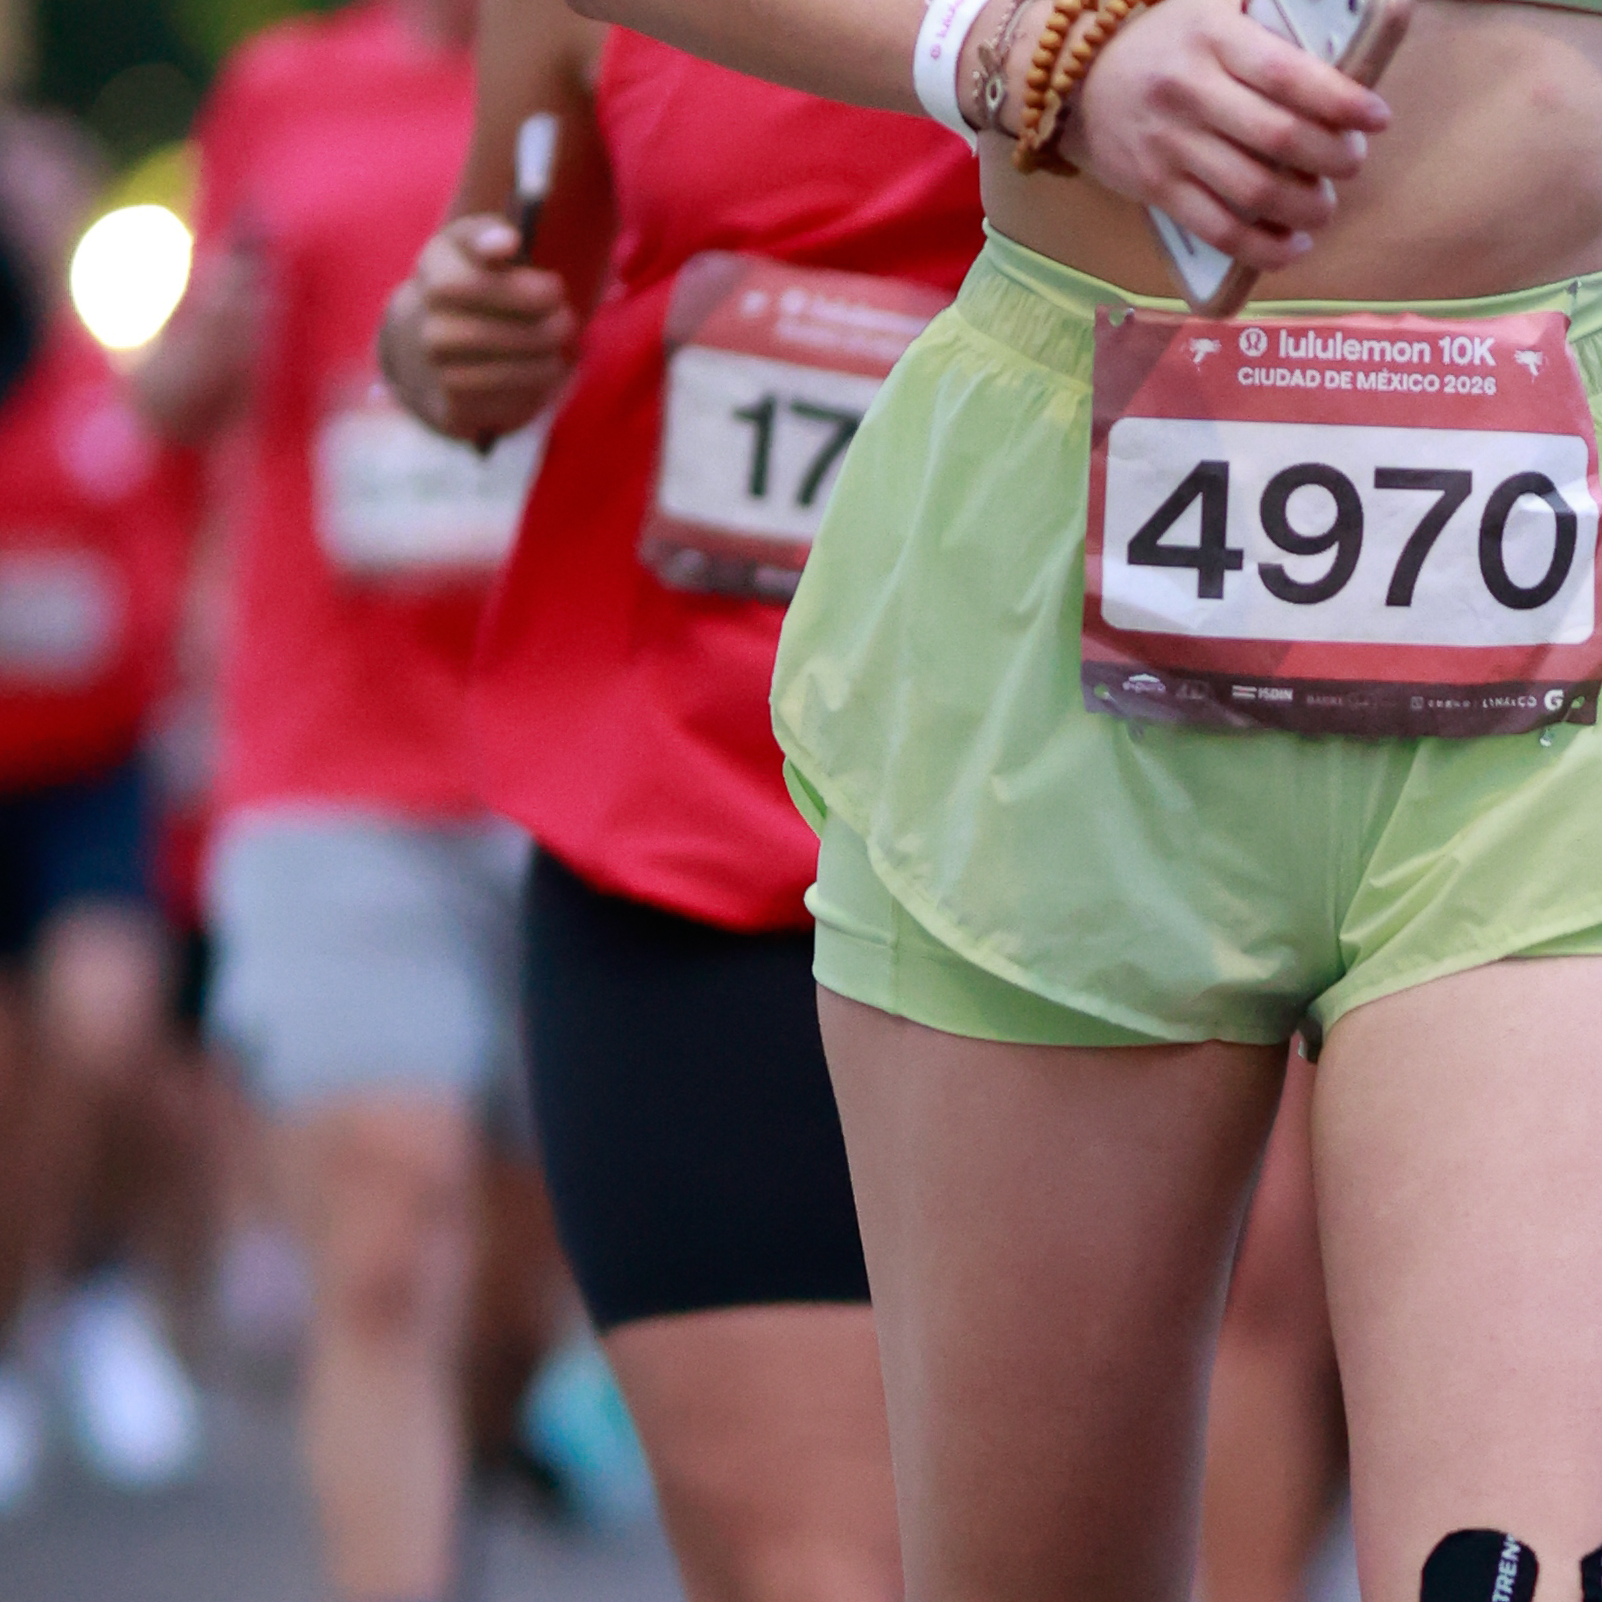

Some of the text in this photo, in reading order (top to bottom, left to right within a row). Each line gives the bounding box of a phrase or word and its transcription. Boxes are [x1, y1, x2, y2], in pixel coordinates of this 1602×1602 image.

[1279, 329, 1496, 366] lululemon 10K
[1237, 367, 1497, 395] CIUDAD DE MÉXICO 2026
[1127, 460, 1578, 610] 4970
